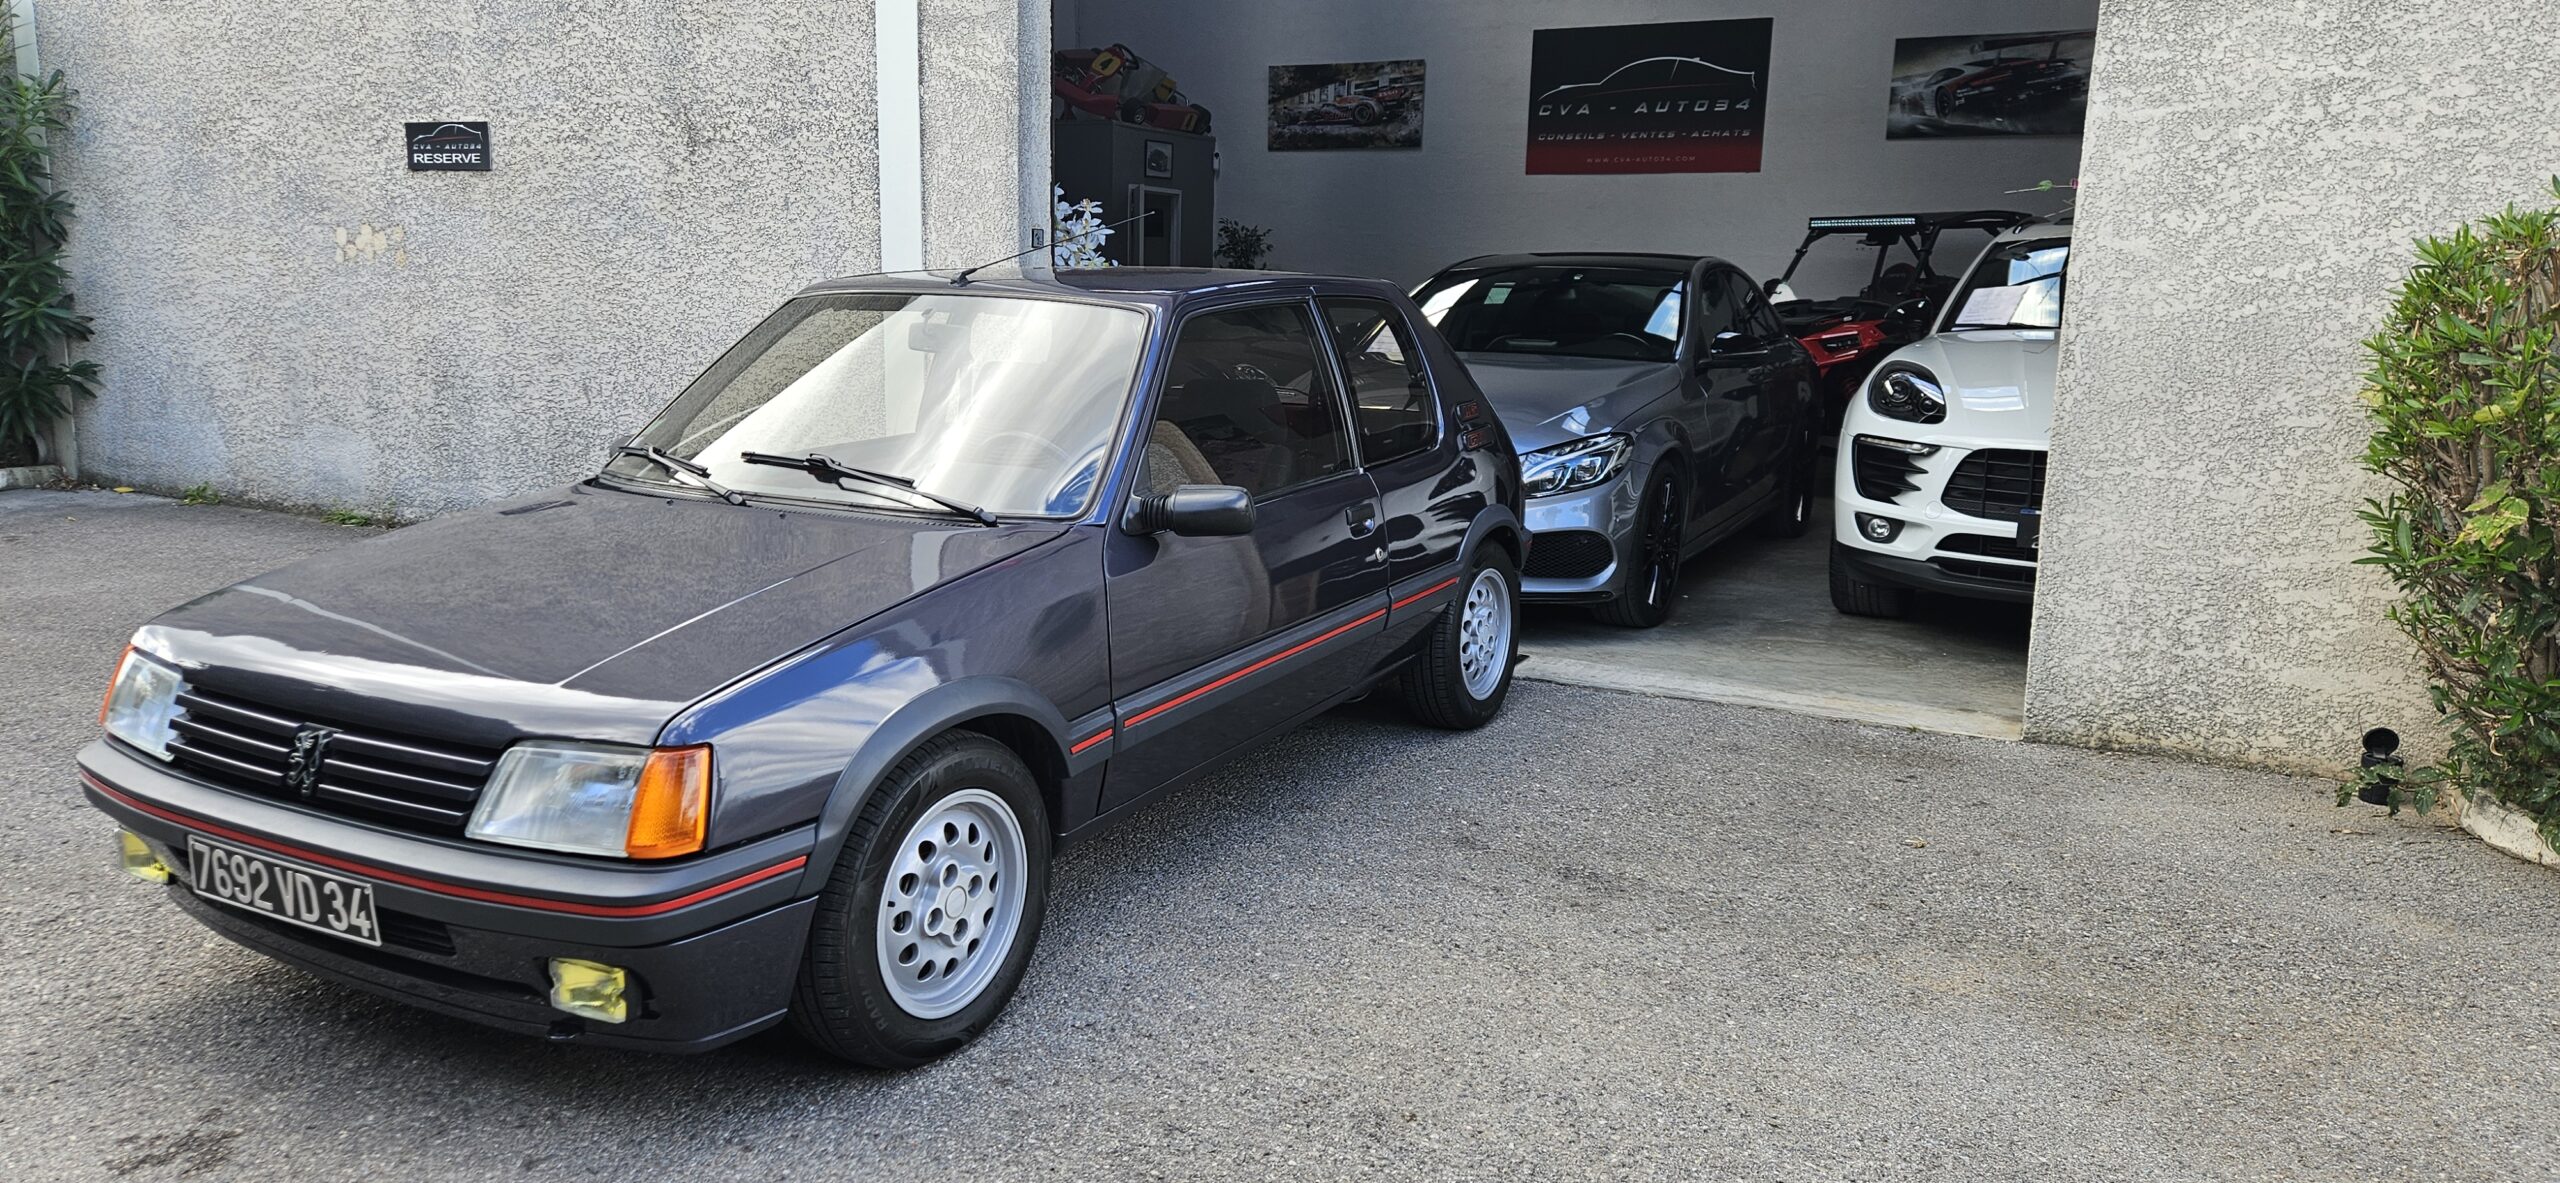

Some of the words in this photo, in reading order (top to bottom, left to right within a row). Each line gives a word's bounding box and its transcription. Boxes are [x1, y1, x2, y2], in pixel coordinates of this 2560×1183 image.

[1538, 103, 1591, 116] CVA
[1634, 98, 1751, 114] AUTO34
[1537, 131, 1605, 141] CONSEILS
[1620, 130, 1676, 139] VENTES
[1690, 129, 1752, 138] ACHATS
[413, 153, 481, 164] RESERVE
[193, 841, 274, 911] 7692
[273, 866, 320, 923] VD
[323, 881, 372, 937] 34
